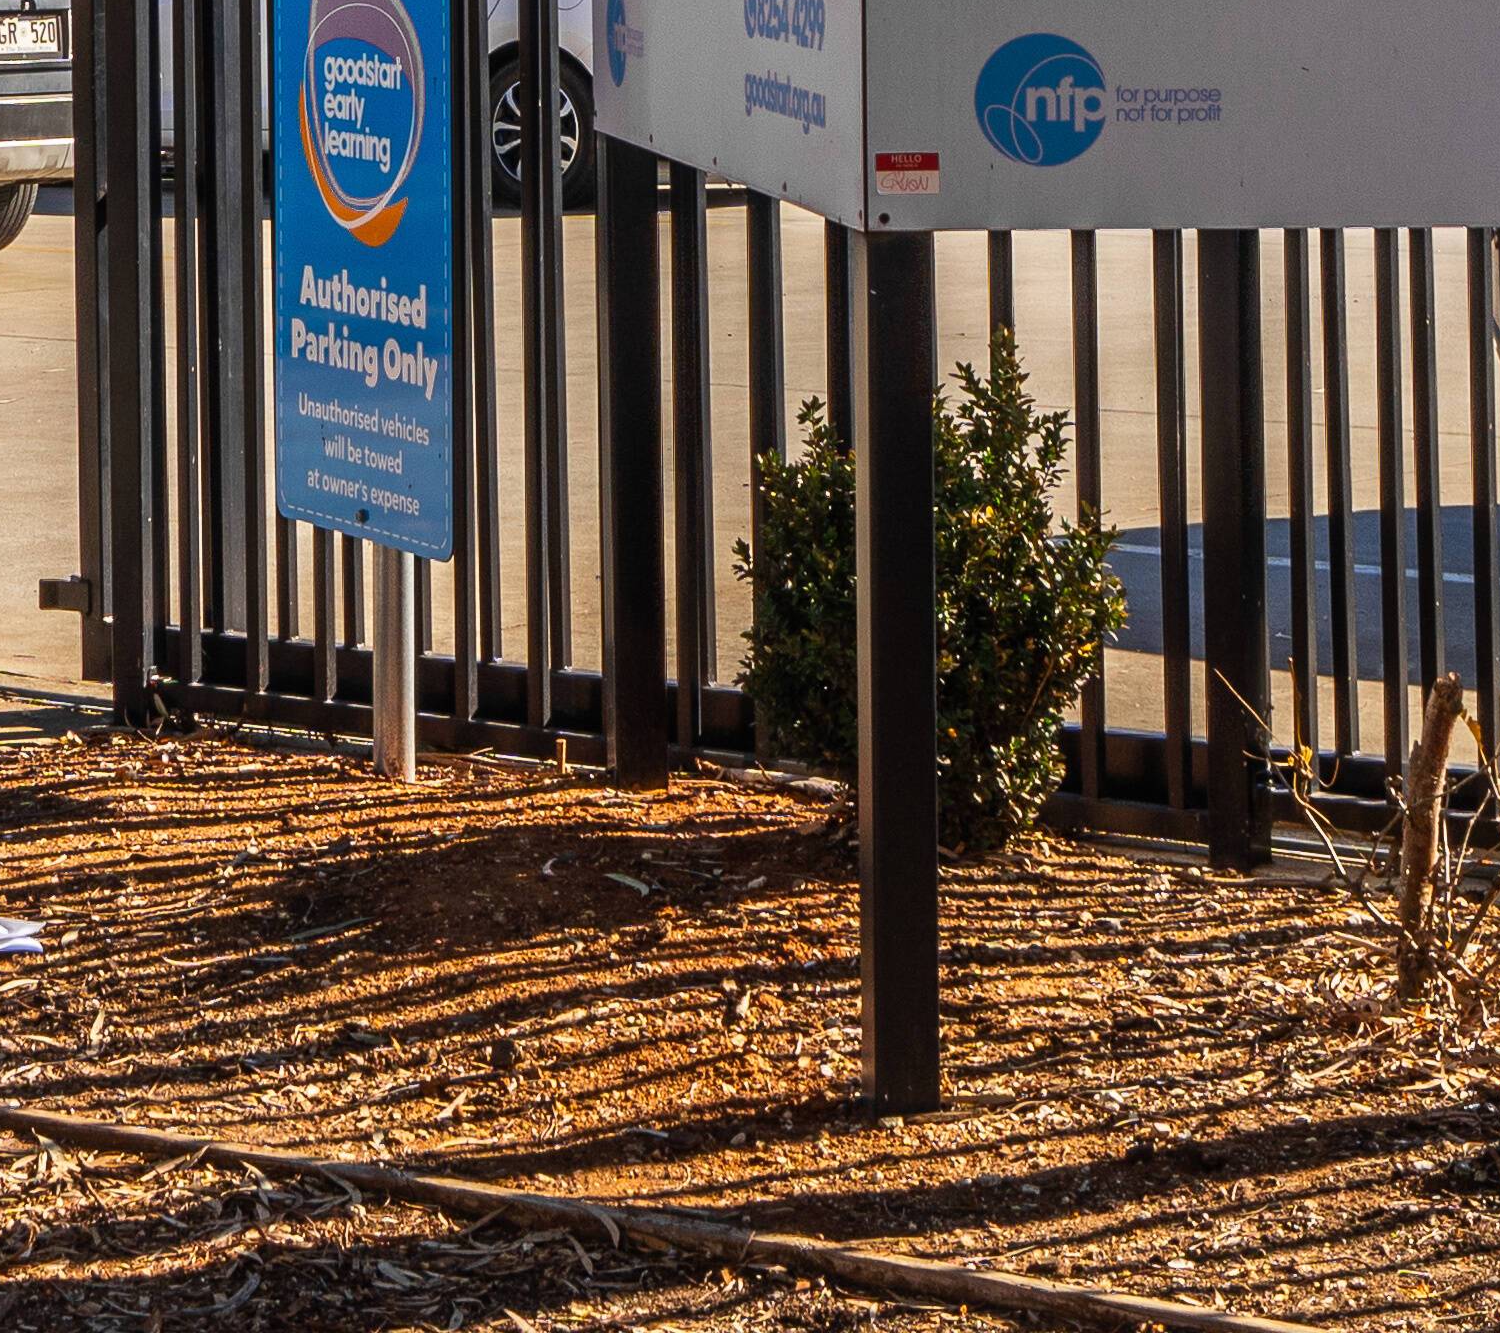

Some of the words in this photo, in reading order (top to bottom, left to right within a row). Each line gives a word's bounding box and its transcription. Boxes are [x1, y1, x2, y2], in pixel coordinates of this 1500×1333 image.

[30, 20, 56, 44] 520
[324, 52, 403, 91] goodstart
[324, 88, 365, 130] early
[744, 69, 827, 135] goodstart.org.au
[1025, 75, 1107, 132] nfp
[1116, 85, 1139, 103] for
[1143, 87, 1222, 106] purpose
[1116, 105, 1145, 122] not
[1150, 105, 1174, 122] for
[1177, 104, 1222, 125] profit
[324, 121, 391, 173] learning
[891, 155, 922, 163] HELLO
[300, 265, 427, 330] Authorised
[291, 318, 379, 388] Parking
[383, 338, 438, 401] Only
[298, 391, 378, 434] Unauthorised
[380, 411, 430, 447] vehicles
[324, 436, 345, 457] will
[347, 438, 362, 464] be
[364, 446, 403, 475] towed
[307, 468, 320, 489] at
[322, 474, 369, 502] owner's
[370, 483, 420, 516] expense
